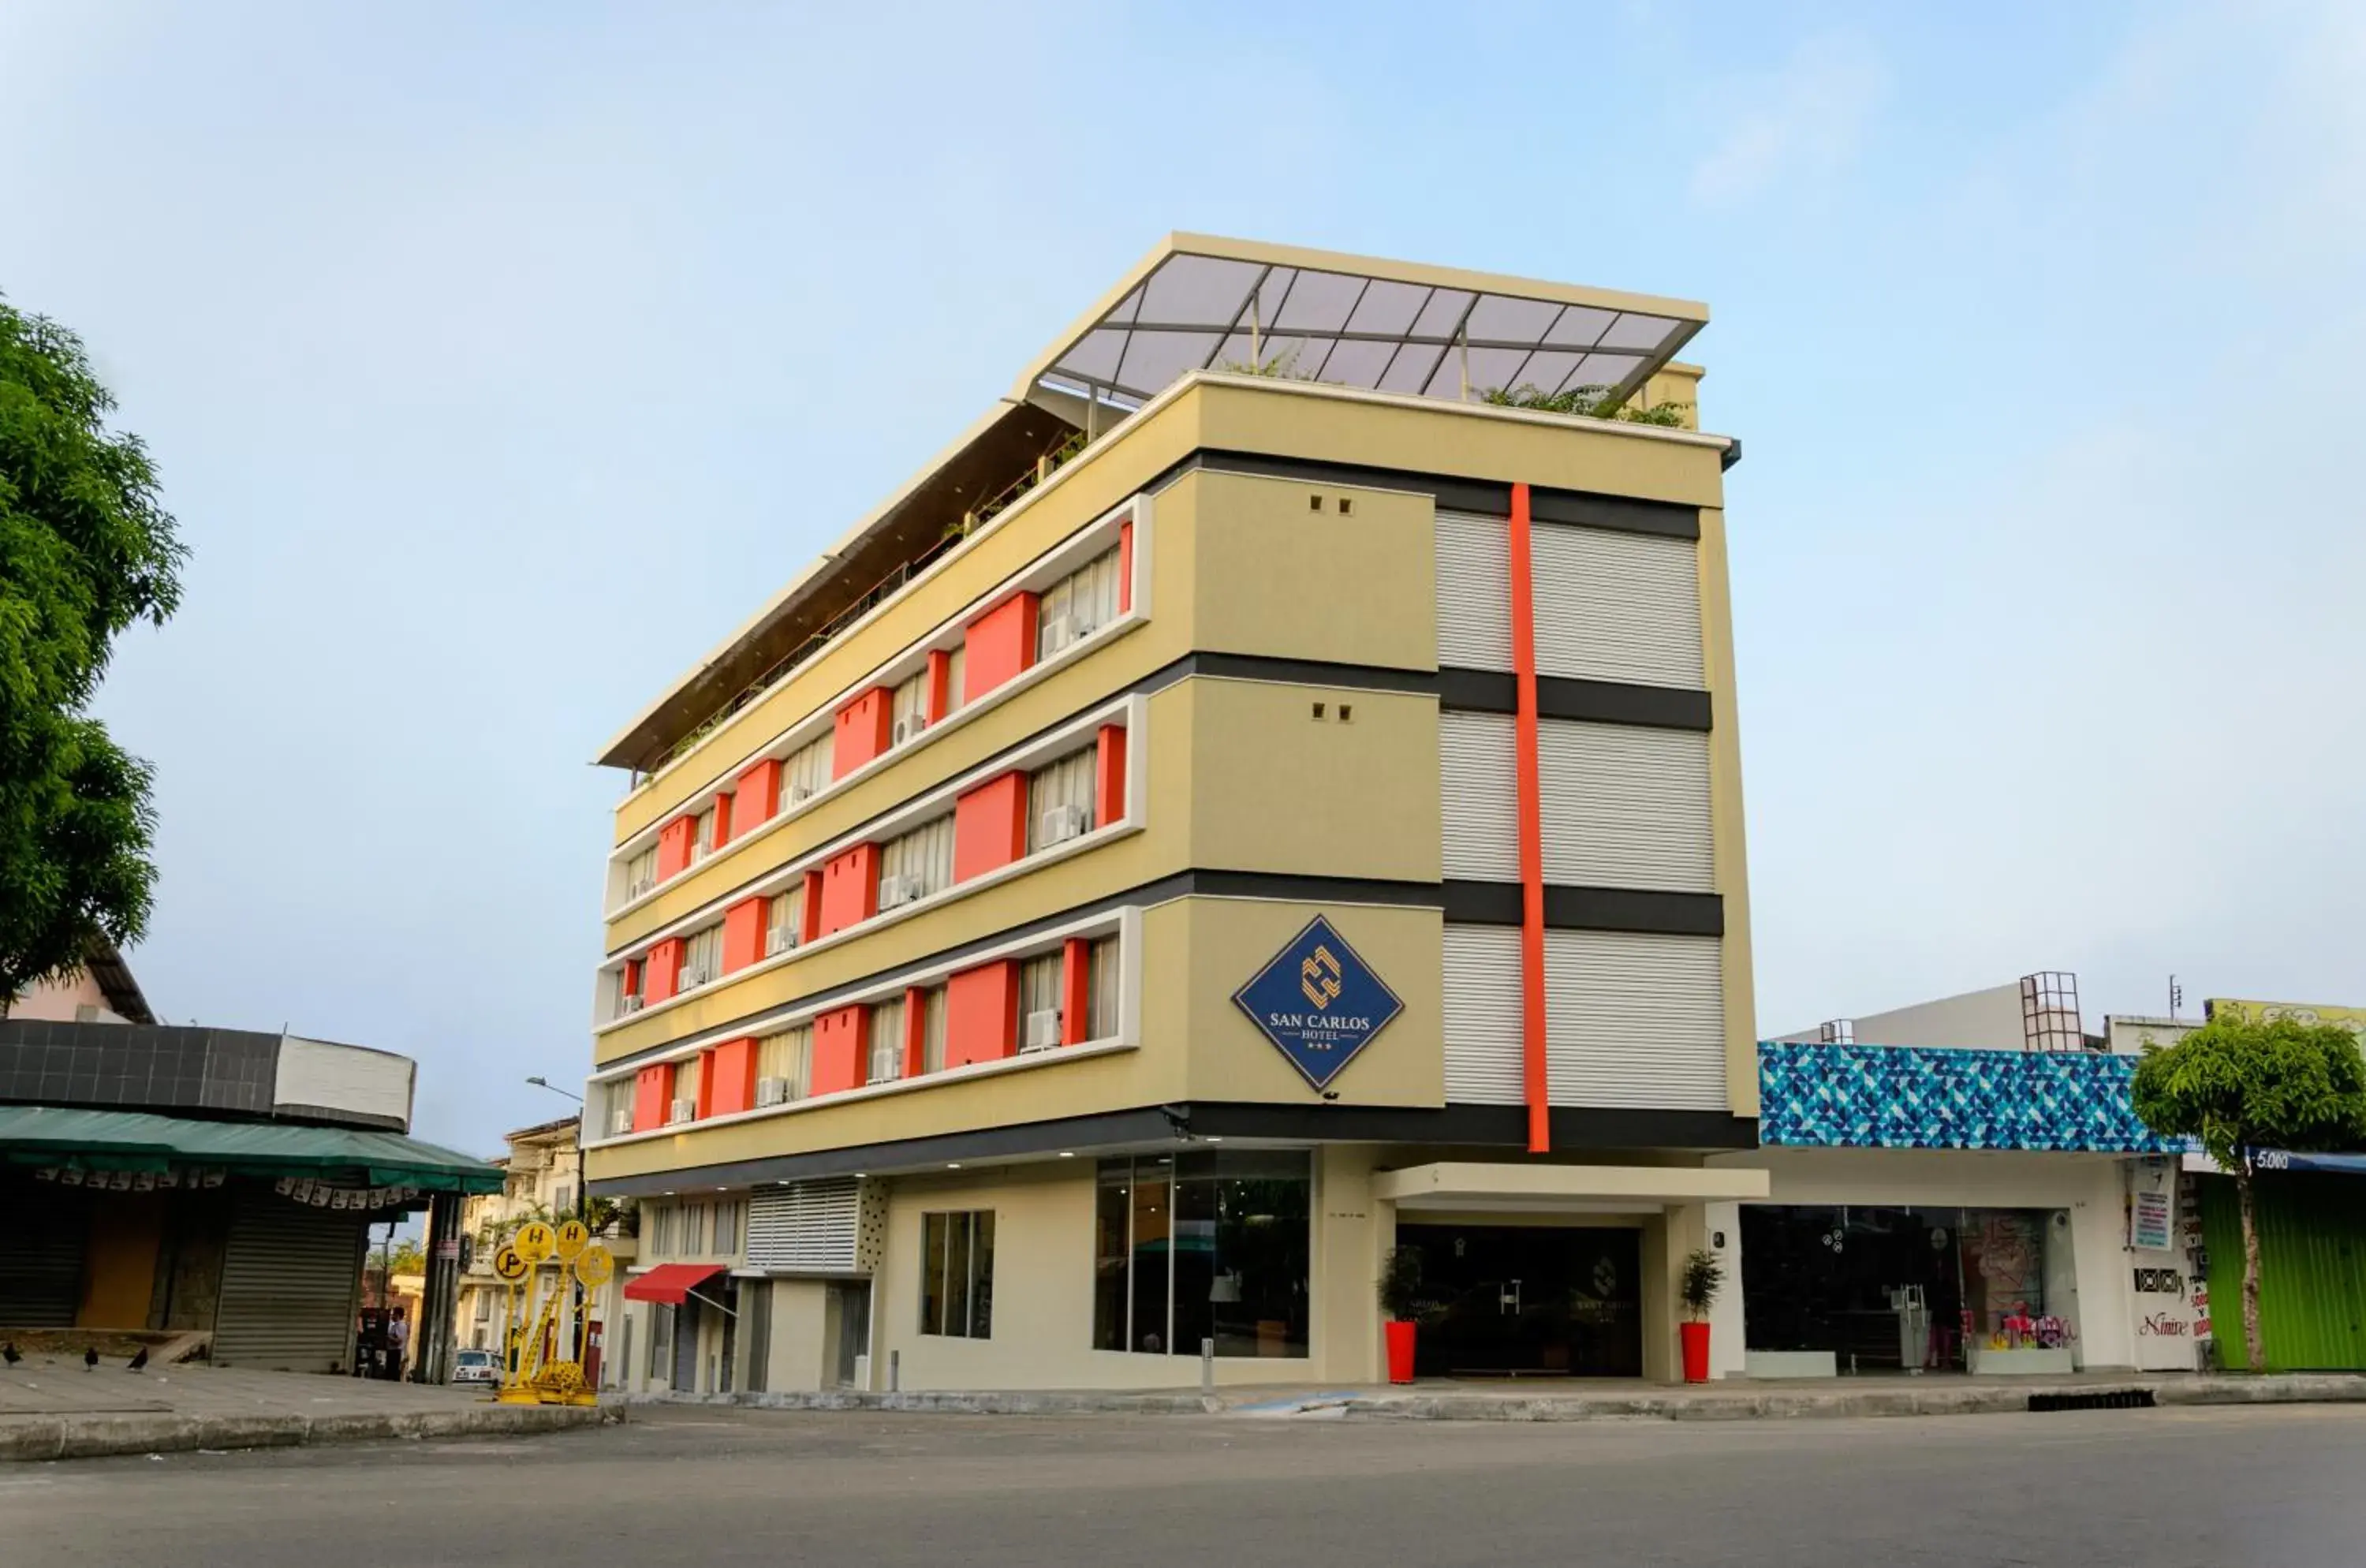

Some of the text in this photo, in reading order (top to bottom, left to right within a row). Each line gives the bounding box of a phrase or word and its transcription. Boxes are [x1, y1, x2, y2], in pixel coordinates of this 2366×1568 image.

[1270, 1013, 1370, 1030] SAN CARLOS
[1301, 1030, 1338, 1040] HOTEL
[506, 1253, 520, 1273] P
